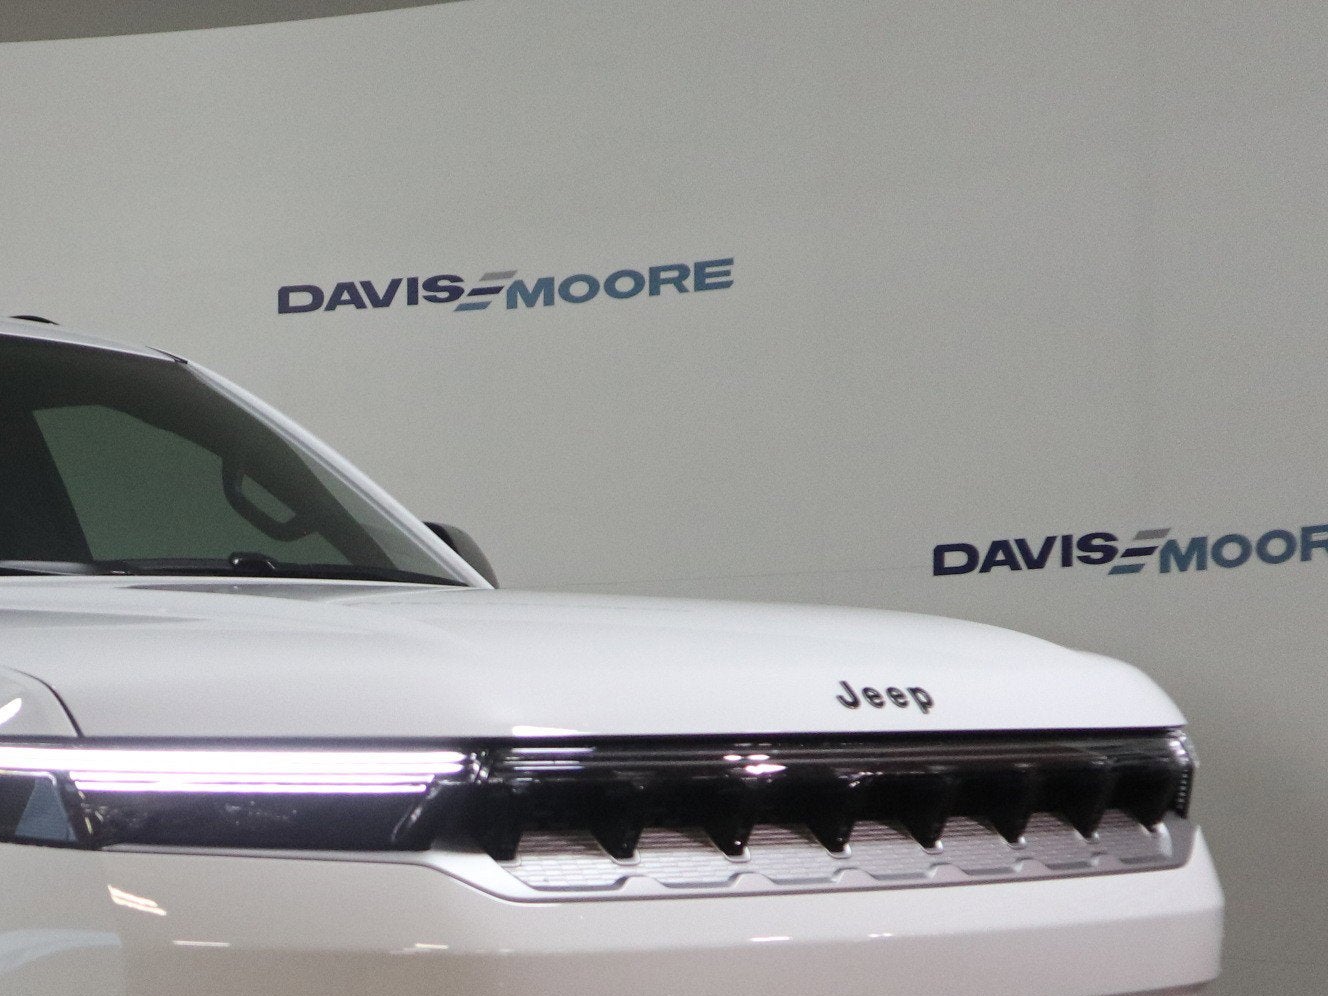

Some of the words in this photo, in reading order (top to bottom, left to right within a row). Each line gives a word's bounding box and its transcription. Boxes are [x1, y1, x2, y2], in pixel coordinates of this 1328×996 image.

[277, 273, 465, 314] DAVIS
[506, 257, 735, 310] MOORE
[932, 532, 1120, 576] DAVIS
[836, 680, 935, 715] Jeep
